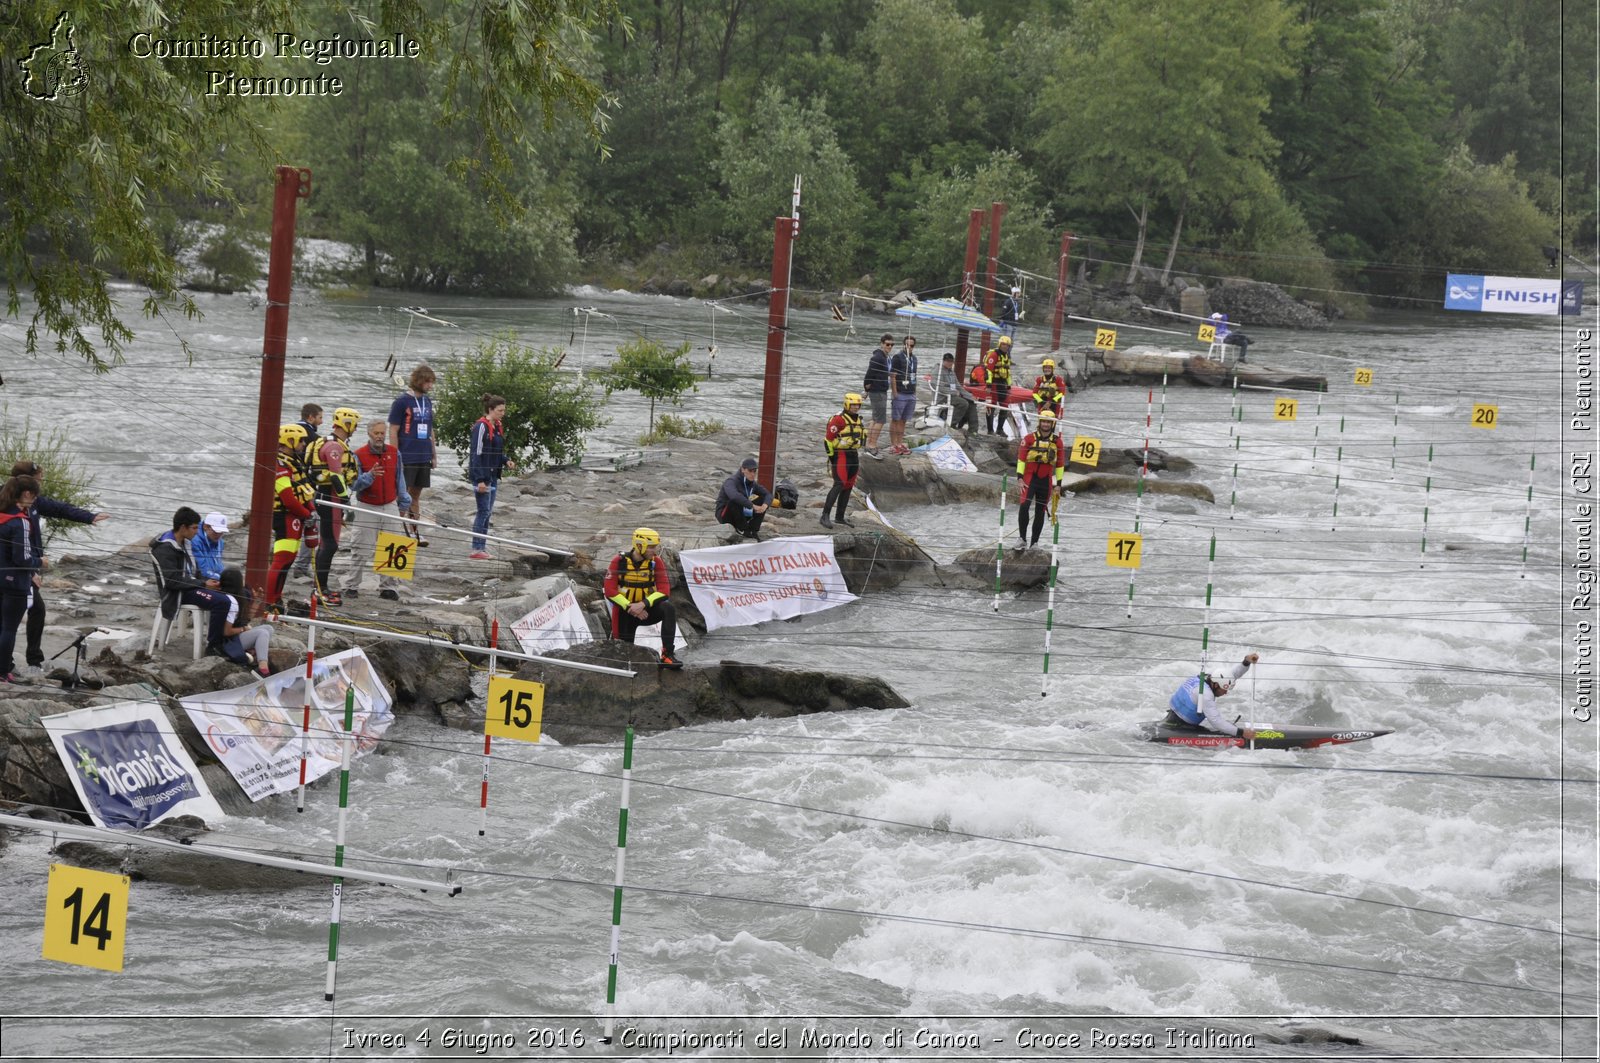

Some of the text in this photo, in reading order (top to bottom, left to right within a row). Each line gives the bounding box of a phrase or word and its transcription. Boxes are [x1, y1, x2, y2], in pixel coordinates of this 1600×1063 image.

[1485, 289, 1557, 303] FINISH
[1098, 333, 1113, 347] 22
[1200, 328, 1213, 339] 24
[1356, 371, 1370, 383] 23
[1278, 403, 1294, 417] 21
[1475, 408, 1495, 424] 20
[1078, 441, 1095, 459] 19
[385, 543, 409, 570] 16
[1115, 539, 1136, 561] 17
[692, 551, 832, 585] CROCE ROSSA ITALIANA
[499, 689, 533, 728] 15
[98, 744, 186, 796] manital
[64, 887, 112, 951] 14
